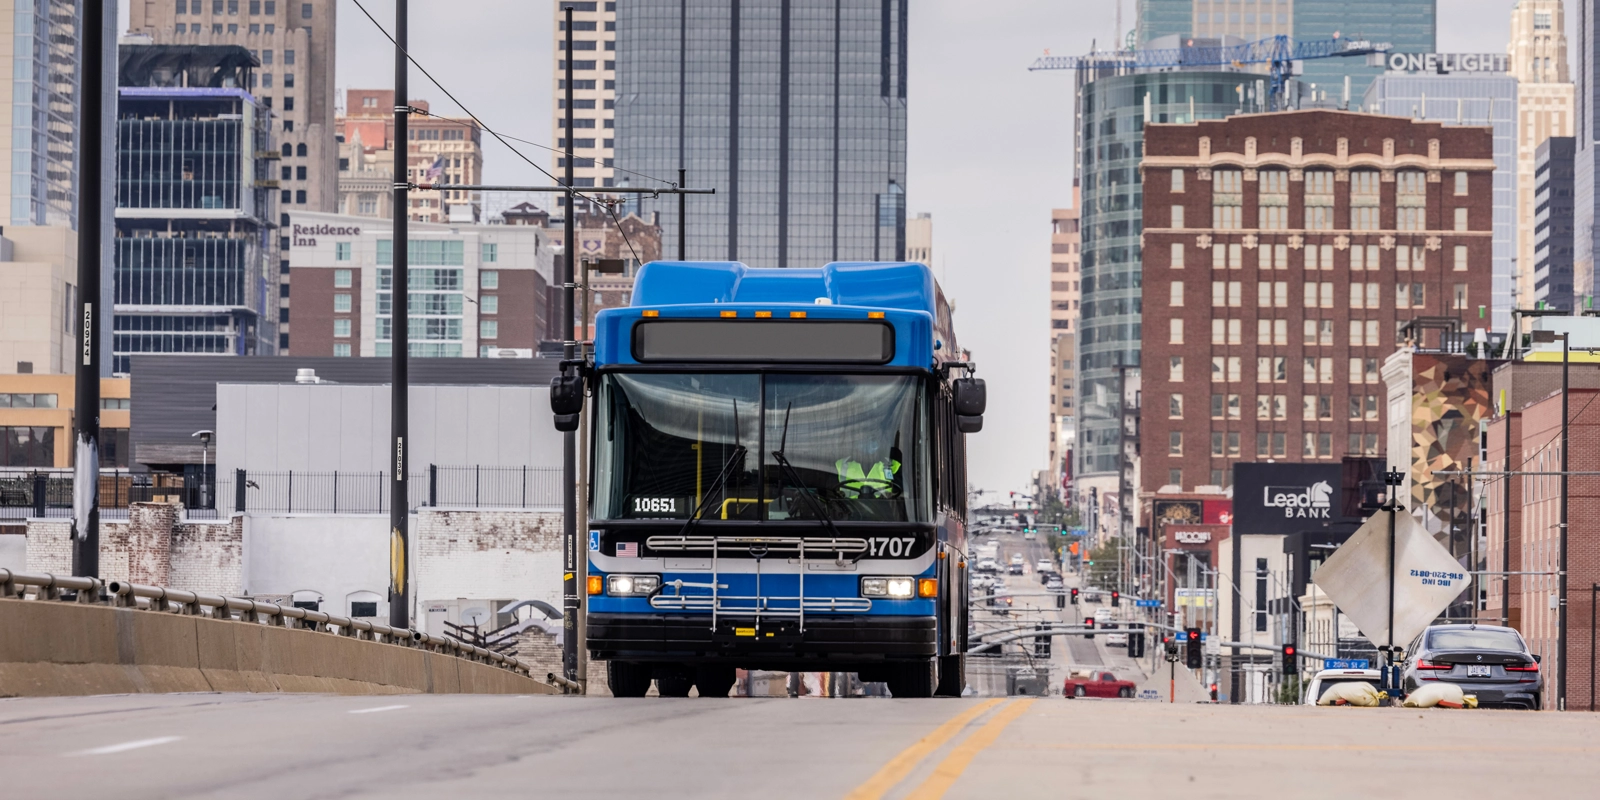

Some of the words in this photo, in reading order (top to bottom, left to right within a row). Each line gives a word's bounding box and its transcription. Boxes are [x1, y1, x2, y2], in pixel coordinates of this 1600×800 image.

[1389, 53, 1437, 71] ONE
[1442, 53, 1509, 71] LIGHT
[292, 223, 361, 236] Residence
[292, 235, 317, 247] Inn
[1264, 485, 1311, 508] Lead
[634, 497, 676, 513] 10651
[1285, 507, 1331, 519] BANK
[1410, 569, 1464, 580] 816-220-0812
[1422, 578, 1436, 586] INC
[1437, 579, 1451, 587] IBC
